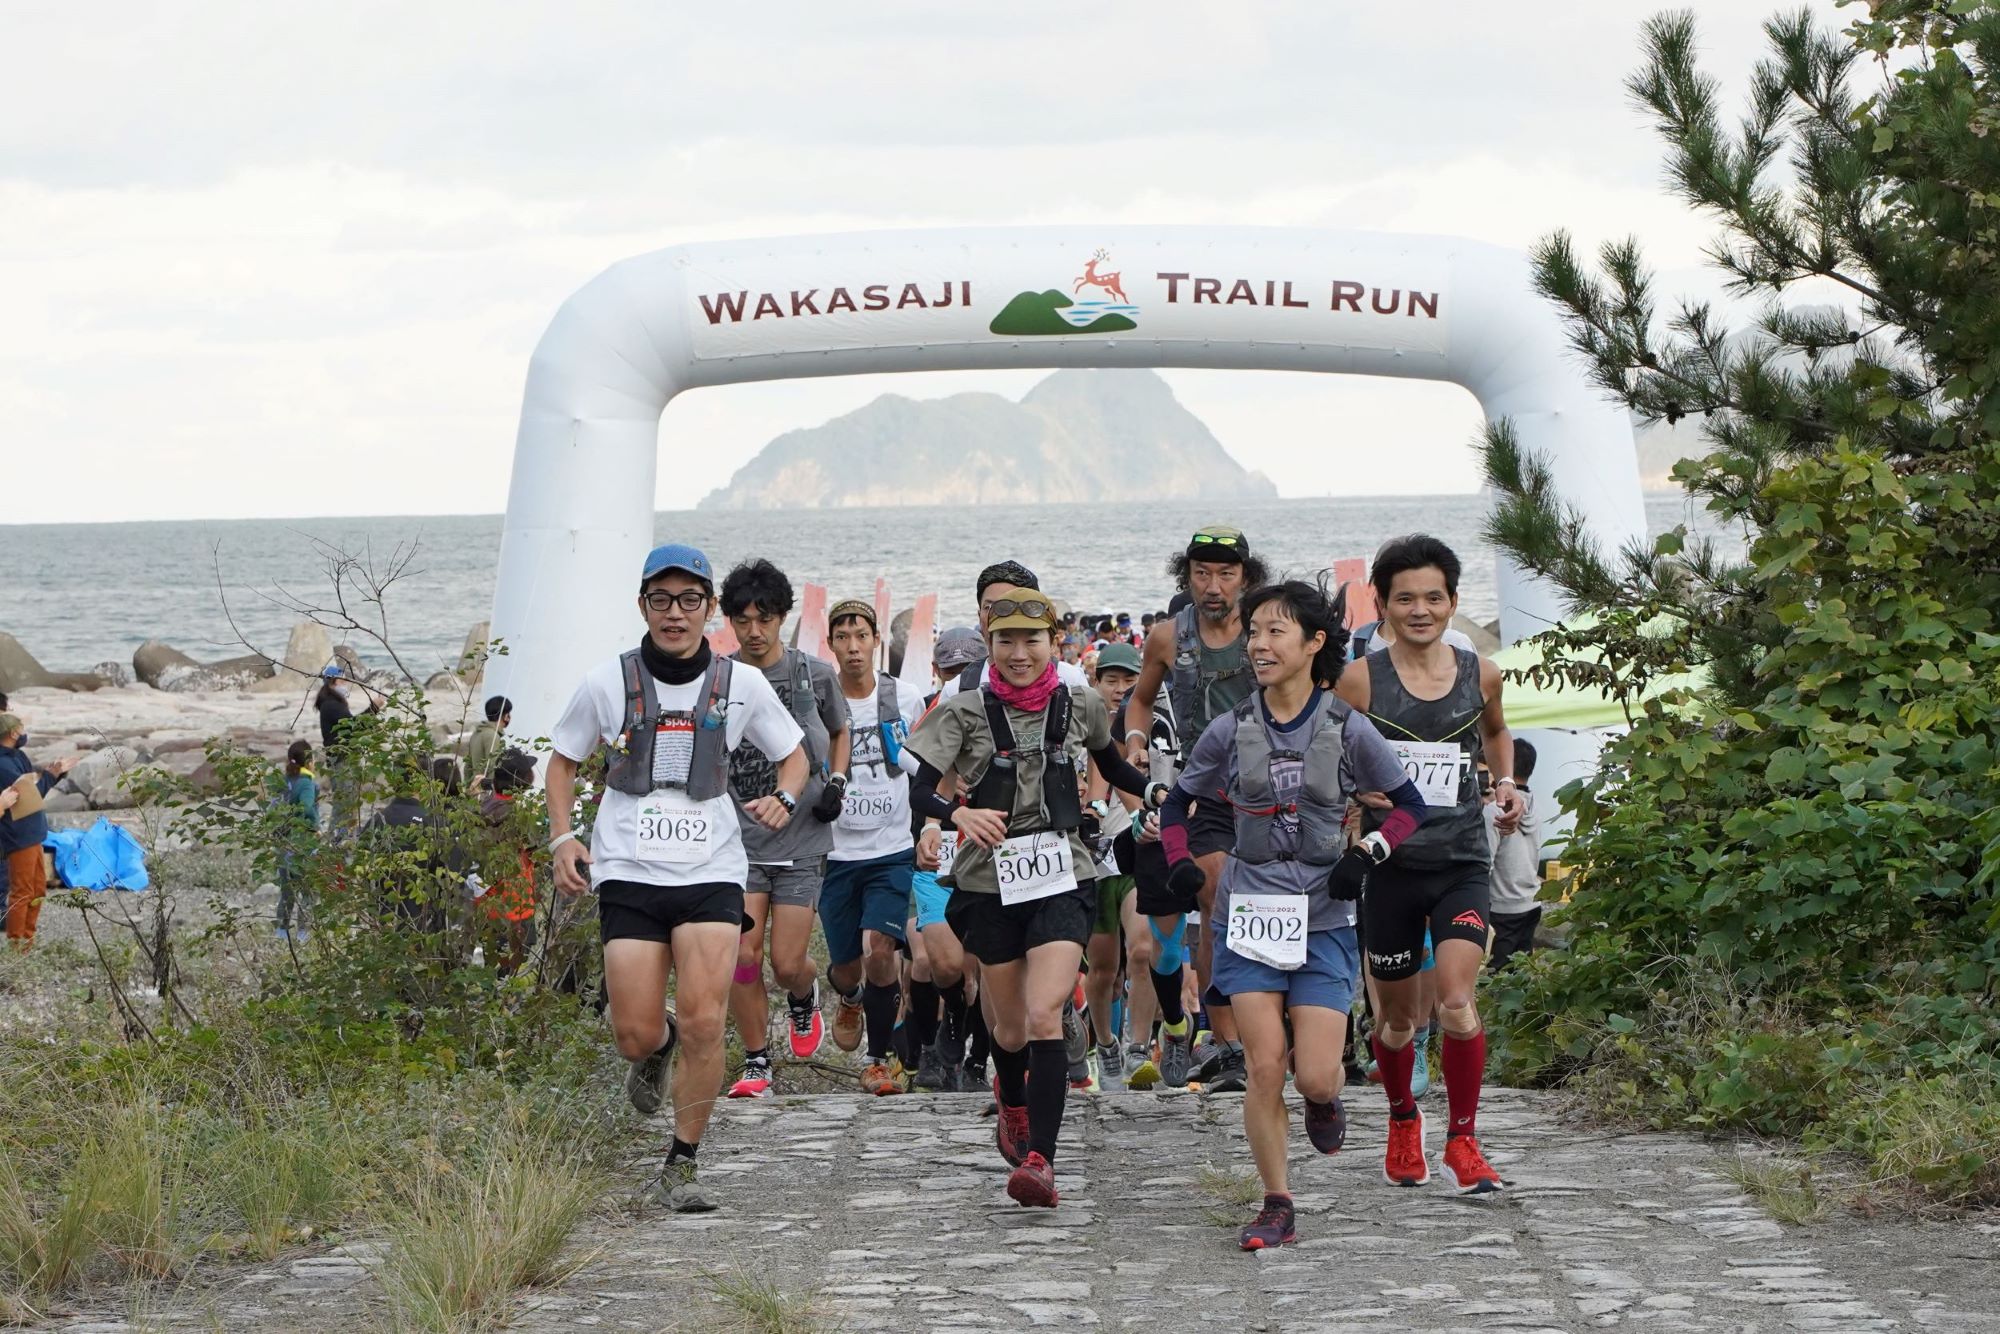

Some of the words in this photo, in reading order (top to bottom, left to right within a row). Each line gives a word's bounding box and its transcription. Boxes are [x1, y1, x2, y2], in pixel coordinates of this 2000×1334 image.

[699, 281, 972, 325] WAKASAJI
[1157, 272, 1309, 309] TRAIL
[1330, 280, 1440, 319] RUN
[1404, 761, 1455, 786] 077
[845, 796, 893, 817] 3086
[639, 817, 707, 842] 3062
[1040, 841, 1059, 850] 2022
[999, 850, 1067, 884] 3001
[1230, 915, 1302, 942] 3002
